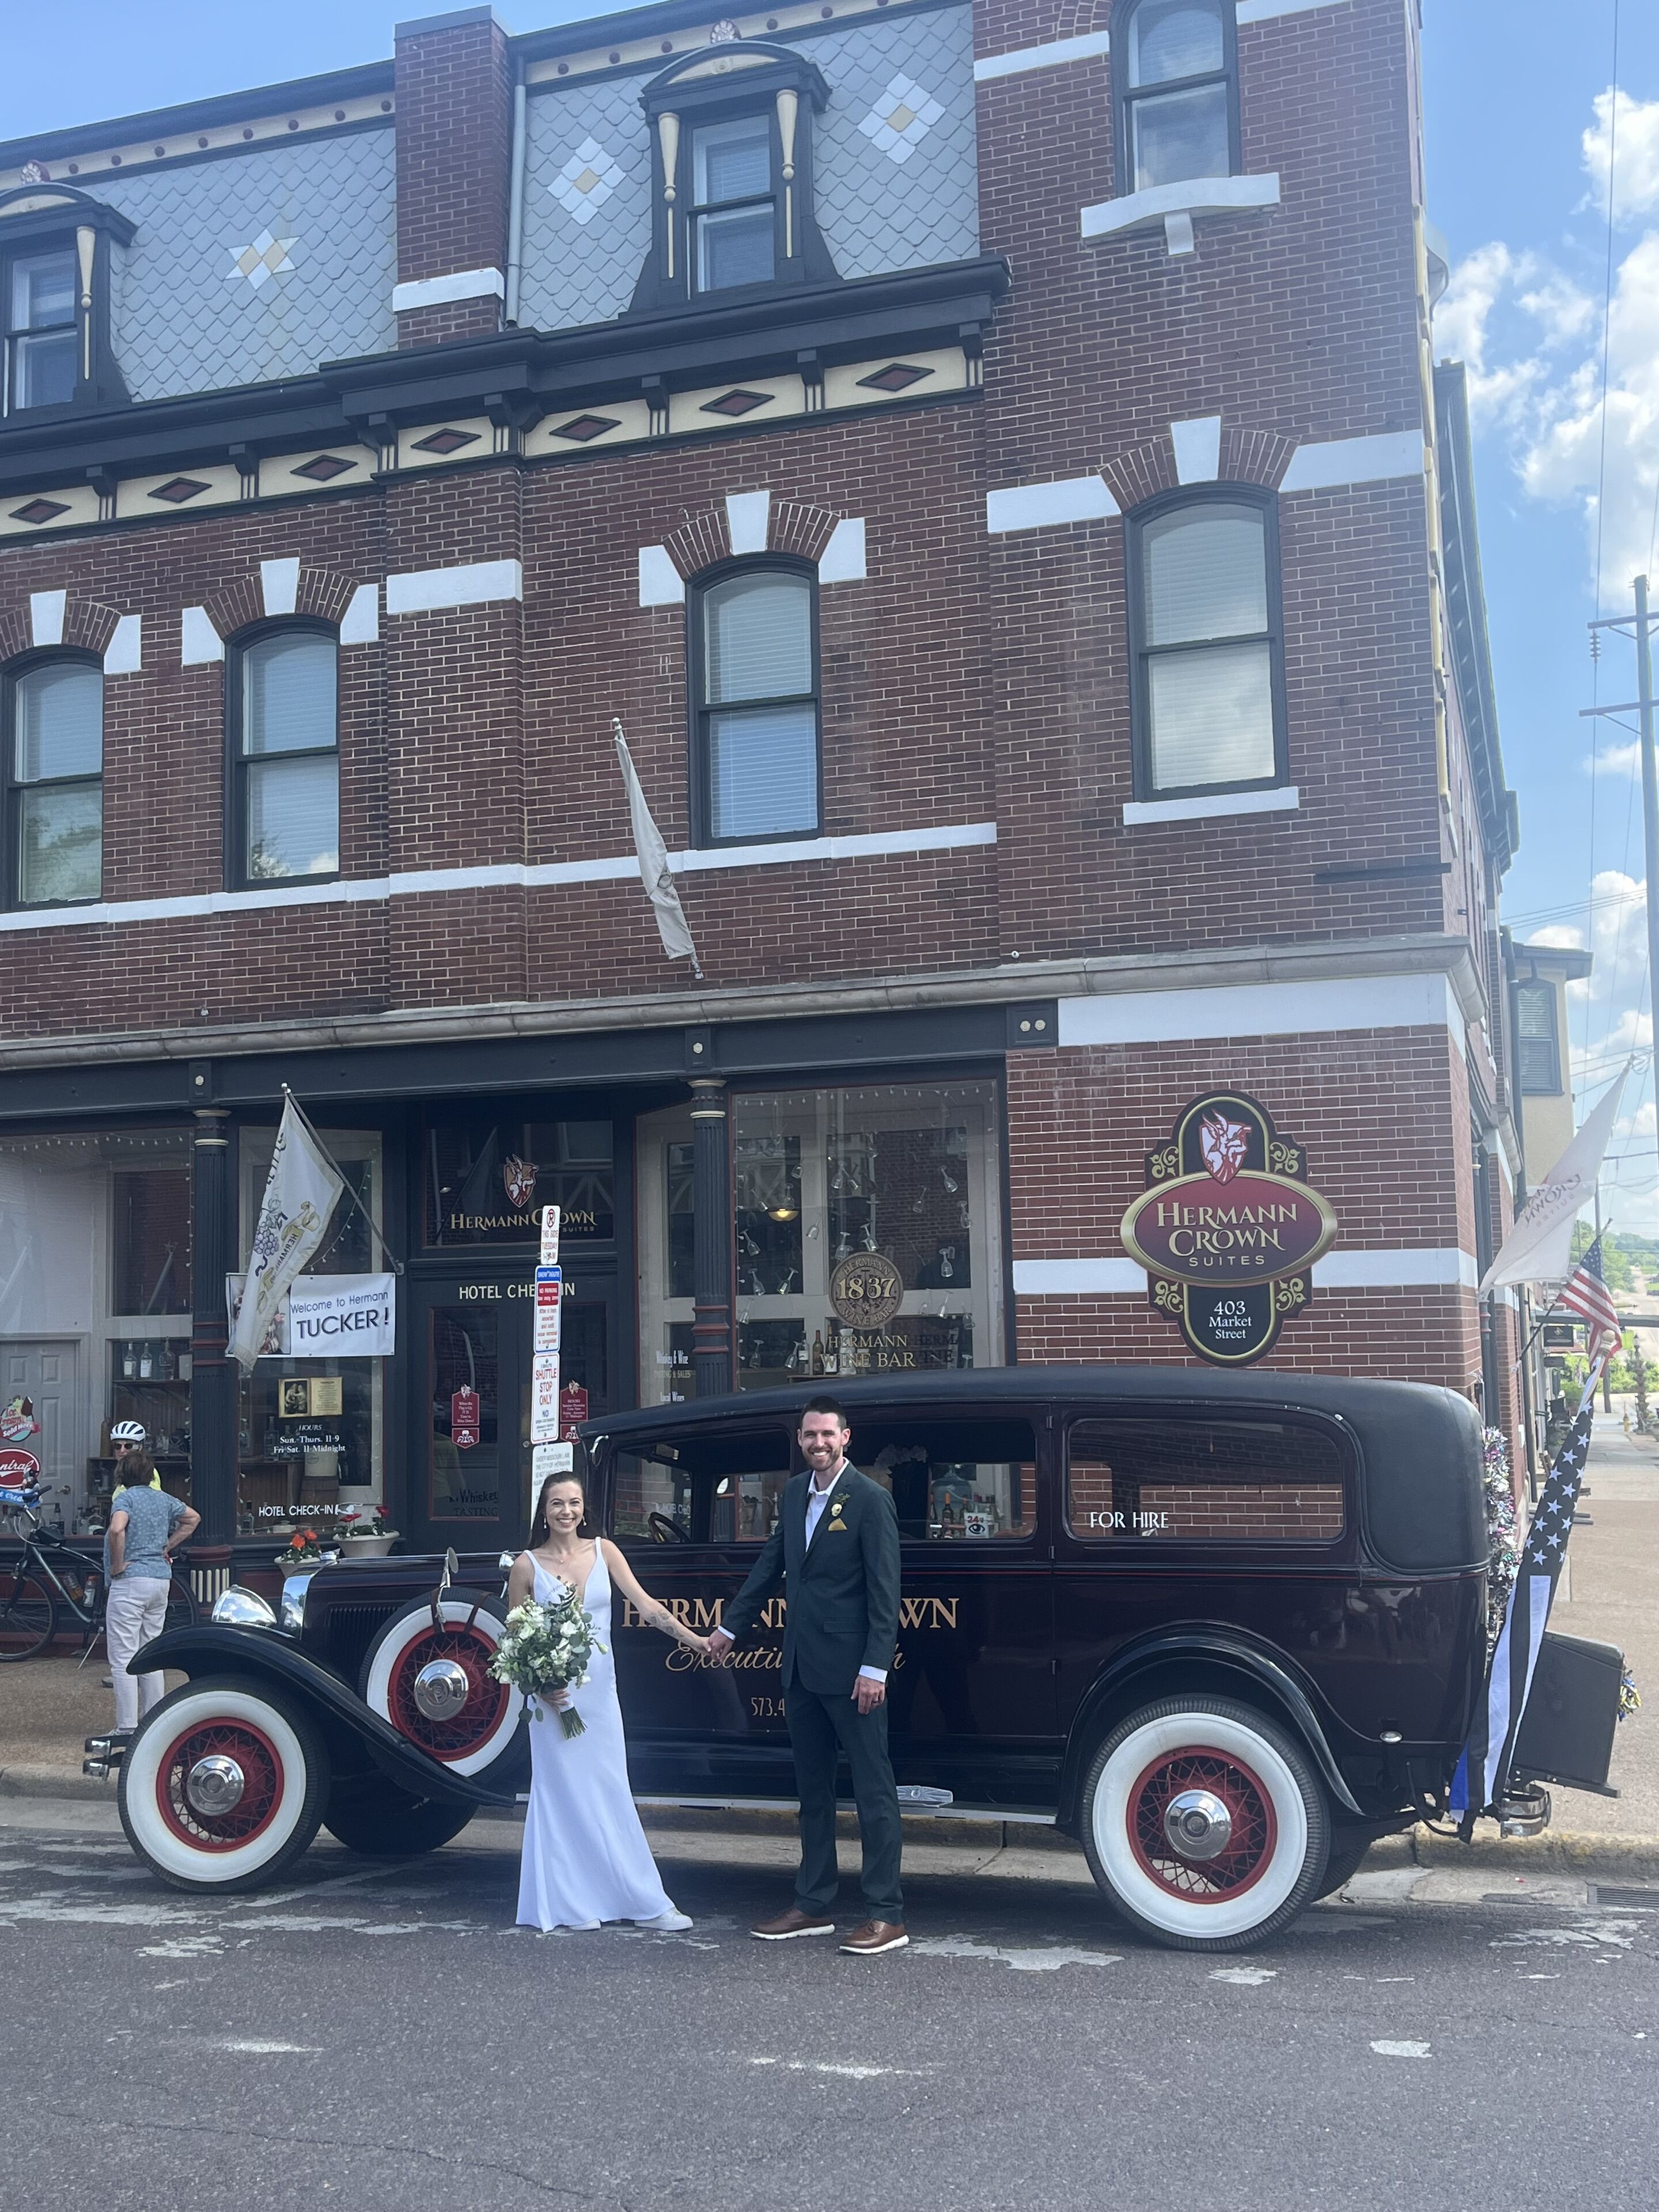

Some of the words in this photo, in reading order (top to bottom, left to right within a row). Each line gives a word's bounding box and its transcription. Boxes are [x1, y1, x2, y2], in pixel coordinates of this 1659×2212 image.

[451, 1213, 529, 1230] HERMANN
[531, 1208, 598, 1226] COWN
[1157, 1202, 1297, 1229] HERMANN
[1169, 1226, 1286, 1256] CROWN
[843, 1257, 891, 1276] HERMANN
[1189, 1255, 1265, 1267] SUITES
[459, 1286, 502, 1300] HOTEL
[838, 1278, 896, 1300] 1837
[291, 1301, 332, 1313] Welcome
[336, 1297, 345, 1308] to
[349, 1291, 388, 1305] Hermann
[1214, 1301, 1246, 1316] 403
[842, 1306, 870, 1325] WINE
[874, 1306, 893, 1323] BAR
[1209, 1316, 1252, 1327] Market
[828, 1334, 908, 1349] HERMANN
[1215, 1329, 1246, 1339] Street
[820, 1353, 871, 1368] WINE
[877, 1351, 916, 1368] BAR
[536, 1368, 557, 1381] SHUTTLE
[539, 1381, 553, 1393] STOP
[539, 1394, 553, 1406] ONLY
[2, 1427, 18, 1438] Sold
[18, 1422, 33, 1431] Here
[259, 1505, 286, 1517] HOTEL
[289, 1504, 334, 1516] CHECK-IN
[1090, 1512, 1126, 1529] FOR
[1132, 1512, 1169, 1529] HIRE
